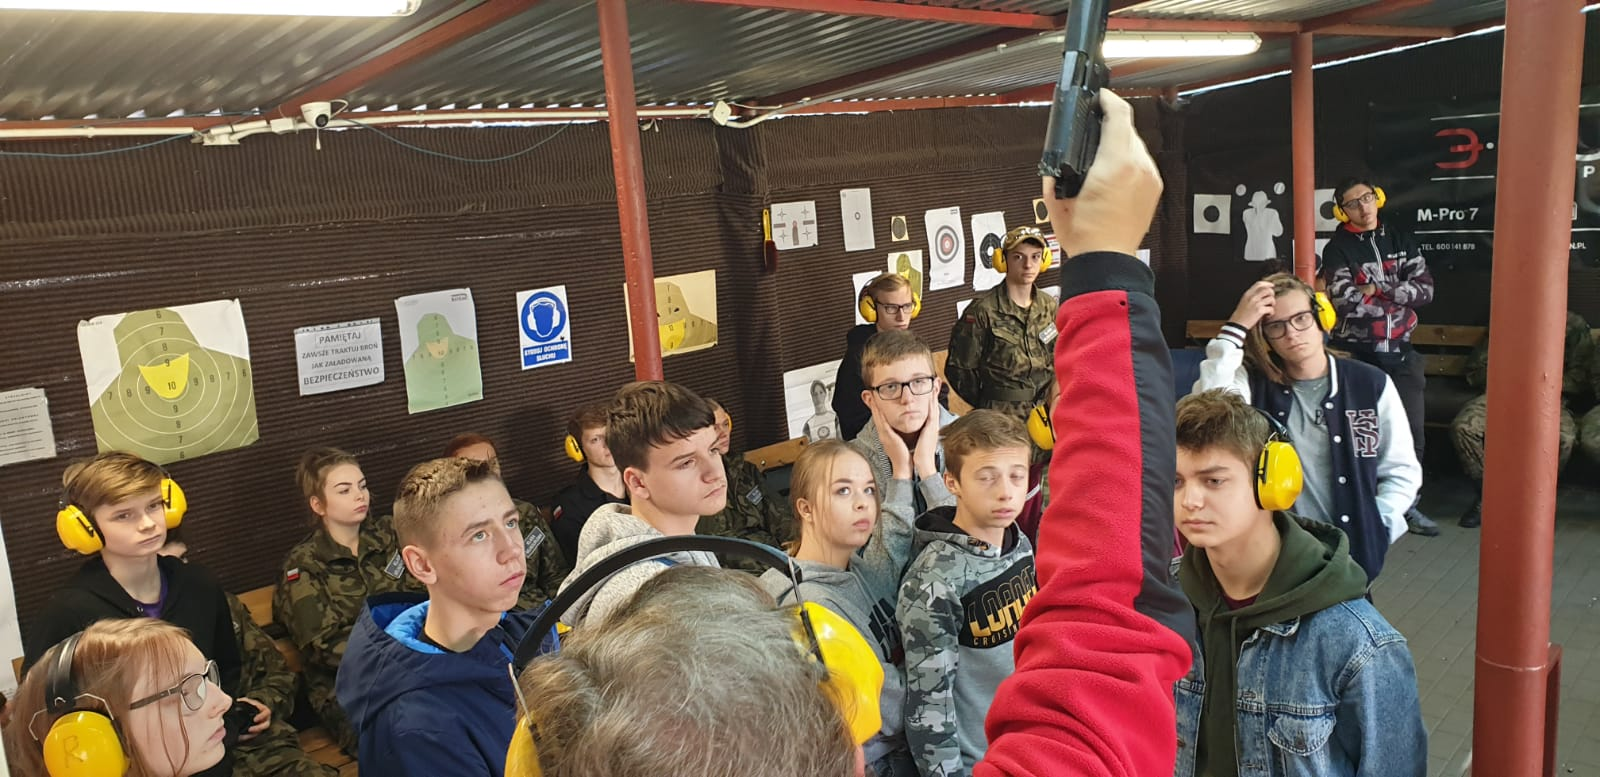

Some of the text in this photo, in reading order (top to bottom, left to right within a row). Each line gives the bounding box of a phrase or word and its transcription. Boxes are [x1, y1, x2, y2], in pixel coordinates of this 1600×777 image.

[1469, 207, 1479, 221] 7
[155, 310, 162, 319] 6
[159, 326, 164, 336] 7
[319, 331, 361, 344] PAMIĘTAJ
[161, 342, 168, 352] 8
[302, 349, 329, 359] ZAWSZE
[331, 344, 359, 355] TRAKTUJ
[164, 358, 170, 367] 9
[311, 355, 372, 370] JAK ZAŁADOWANĄ
[303, 366, 380, 385] BEZPIECZEŃSTWO
[167, 381, 177, 390] 10
